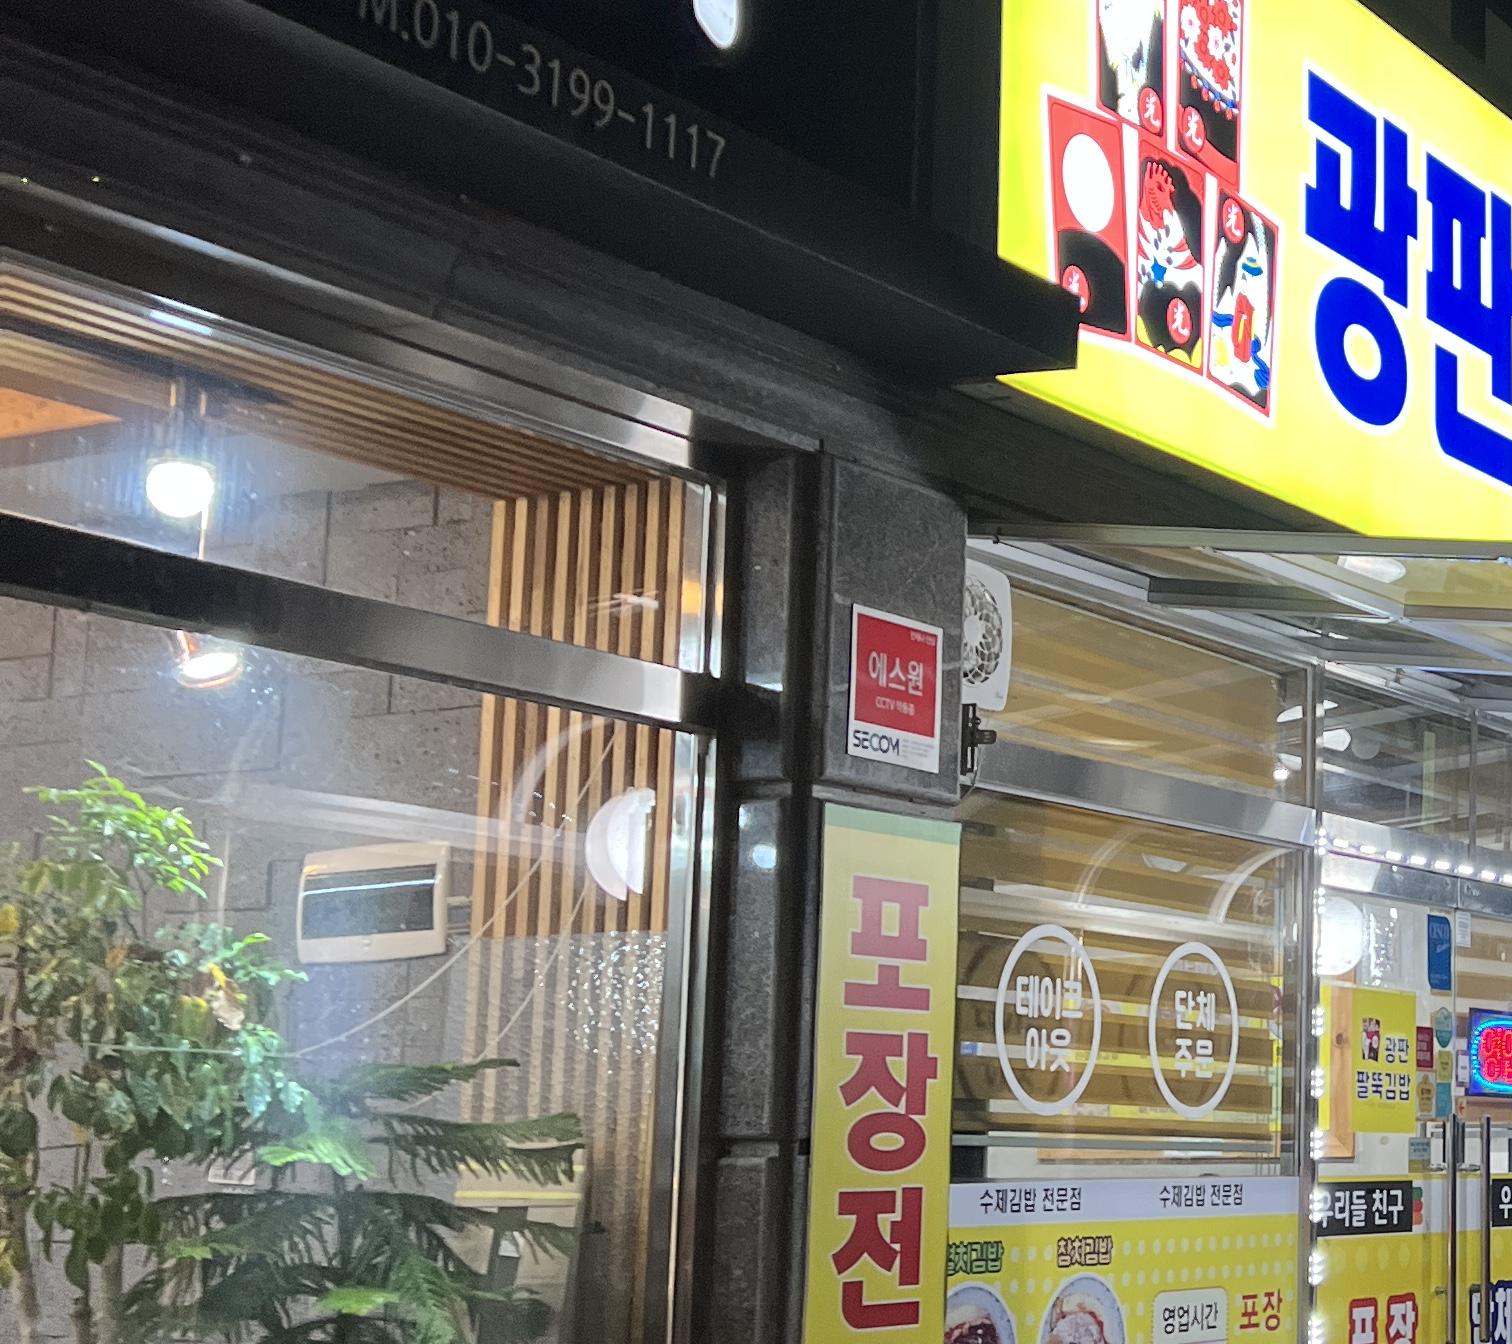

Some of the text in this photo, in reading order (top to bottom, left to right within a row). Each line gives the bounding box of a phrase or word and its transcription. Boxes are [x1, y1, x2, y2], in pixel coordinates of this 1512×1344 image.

[868, 650, 924, 697] 에스원
[852, 729, 900, 756] SECOM
[1015, 975, 1084, 1020] 테이크
[1174, 990, 1217, 1032] 단체
[1025, 1027, 1072, 1073] 아웃
[1174, 1038, 1214, 1079] 주문
[979, 1186, 1083, 1214] 수제김밥 전문점
[1159, 1183, 1244, 1208] 수제김밥 전문점
[1371, 1185, 1405, 1226] 친구
[1057, 1235, 1114, 1268] 참치김밥
[1162, 1303, 1219, 1335] 영업시간
[1239, 1289, 1283, 1333] 포장
